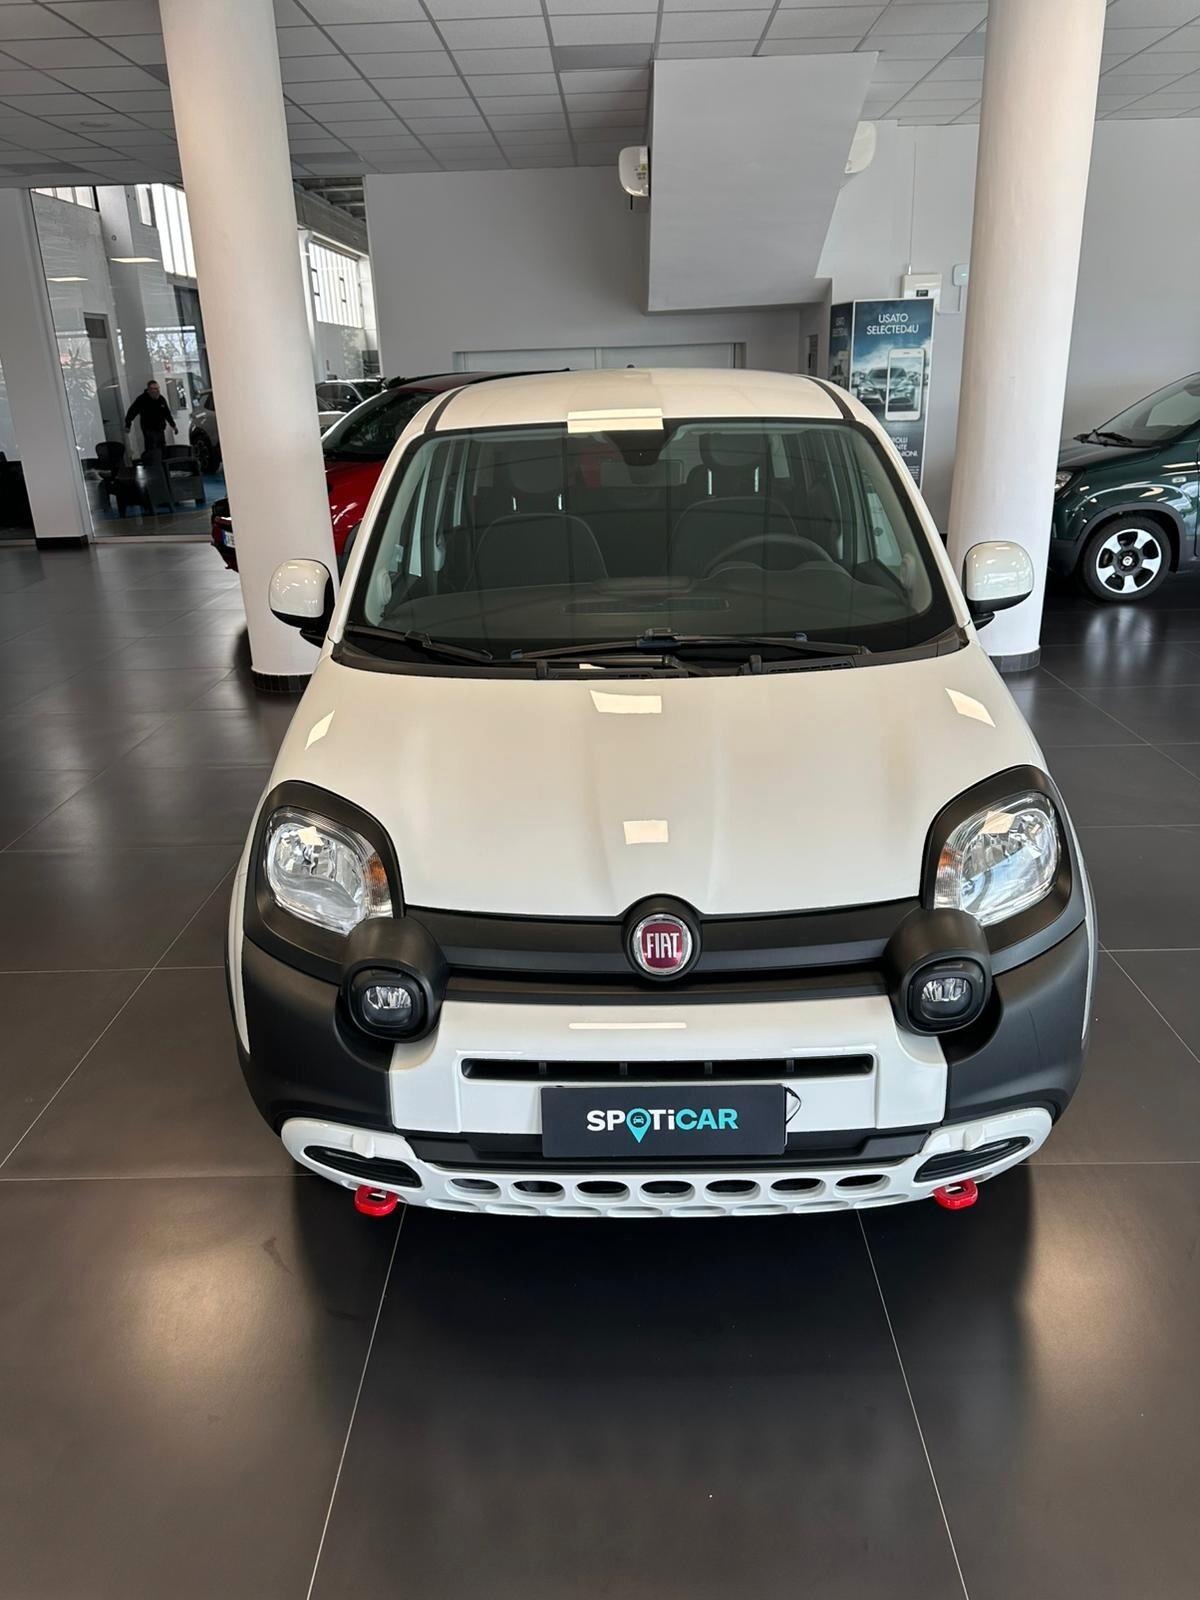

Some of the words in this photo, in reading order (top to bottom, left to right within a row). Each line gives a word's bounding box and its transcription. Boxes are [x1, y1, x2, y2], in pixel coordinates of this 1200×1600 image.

[878, 313, 909, 324] USATO
[866, 324, 919, 335] SELECTED4U
[646, 932, 680, 959] FIAT
